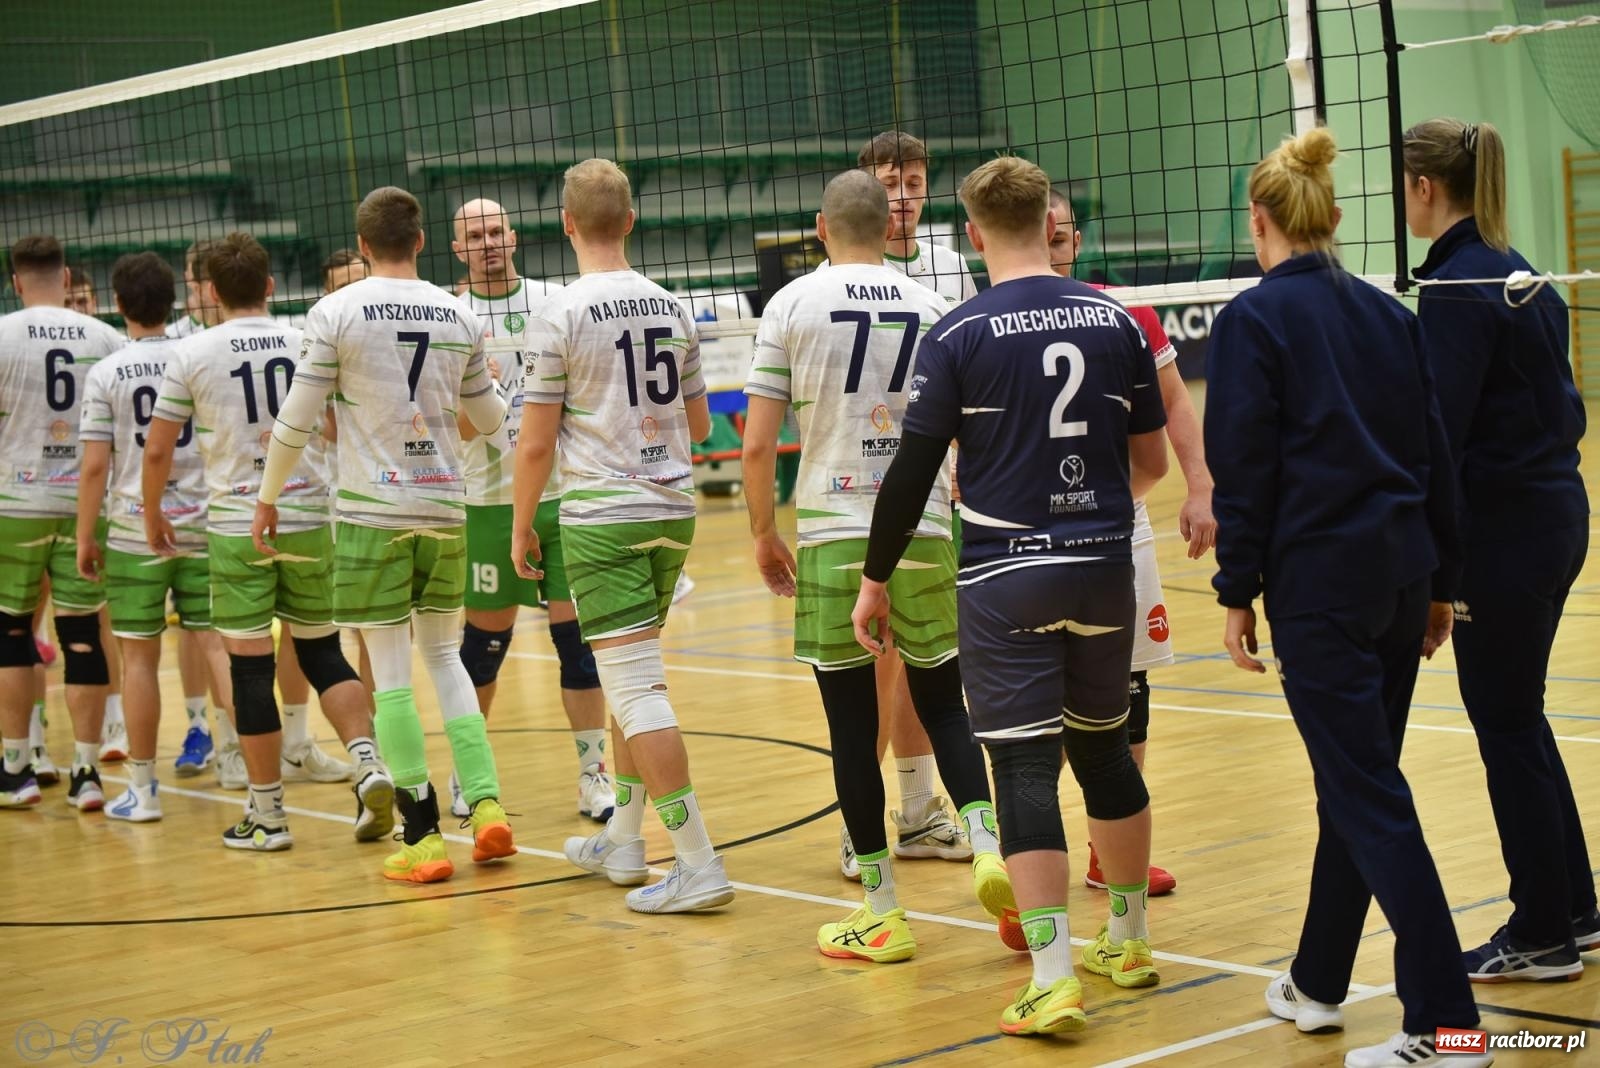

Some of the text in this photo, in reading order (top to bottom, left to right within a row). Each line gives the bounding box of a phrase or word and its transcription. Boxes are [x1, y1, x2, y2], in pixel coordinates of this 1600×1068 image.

[845, 284, 902, 300] KANIA
[363, 303, 457, 324] MYSZKOWSKI
[989, 306, 1121, 338] DZIECHCIAREK
[1163, 303, 1226, 341] ACI
[28, 325, 87, 340] RACZEK
[230, 335, 287, 353] SŁOWIK
[830, 310, 921, 394] 77
[397, 331, 430, 402] 7
[614, 327, 679, 407] 15
[45, 348, 75, 412] 6
[230, 356, 297, 424] 10
[1042, 341, 1088, 439] 2
[404, 441, 417, 450] MK
[862, 437, 901, 449] MK SPOR
[862, 448, 898, 457] FOUNDATI
[1049, 502, 1098, 514] FOUNDATION
[1050, 491, 1095, 506] MK SPORT
[472, 562, 499, 594] 19
